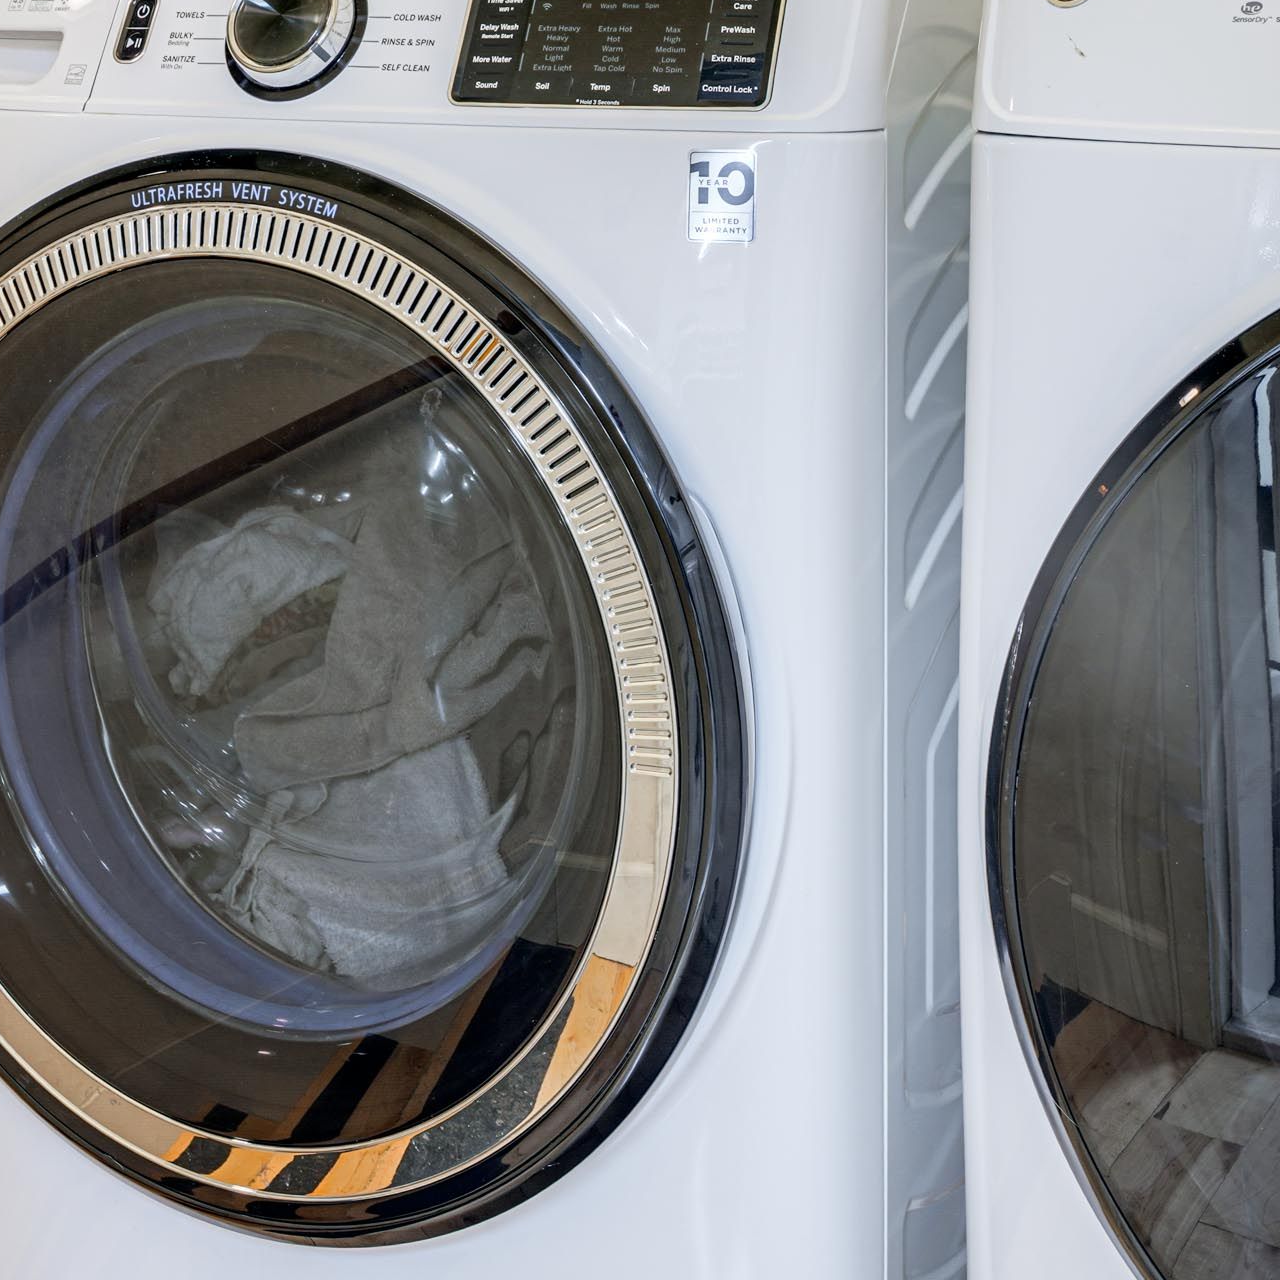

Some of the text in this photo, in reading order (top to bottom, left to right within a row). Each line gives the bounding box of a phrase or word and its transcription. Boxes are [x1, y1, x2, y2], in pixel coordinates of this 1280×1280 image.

[733, 2, 753, 10] Care
[176, 11, 205, 19] TOWELS
[417, 14, 442, 22] WASH
[480, 23, 520, 32] Delay Wash
[538, 24, 581, 34] Extra Heavy
[598, 25, 633, 33] Extra Hot
[721, 25, 756, 34] PreWash
[381, 38, 436, 47] RINSE & SPIN
[546, 34, 569, 43] Heavy
[606, 35, 621, 43] Hot
[663, 36, 681, 45] High
[601, 45, 624, 53] Warm
[472, 55, 512, 63] More Water
[544, 54, 564, 62] Light
[601, 55, 620, 63] Cold
[661, 56, 677, 64] Low
[711, 54, 756, 63] Extra Rinse
[402, 64, 430, 72] CLEAN
[553, 64, 572, 72] Light
[665, 66, 683, 74] Spin
[475, 81, 499, 89] Sound
[535, 82, 550, 90] Soil
[590, 83, 611, 92] Temp
[652, 84, 671, 93] Spin
[702, 84, 753, 93] Control Lock
[690, 161, 755, 206] 10
[698, 178, 729, 186] YEAR
[131, 182, 339, 219] ULTRAFRESH VENT SYSTEM
[695, 226, 747, 234] WARANTY
